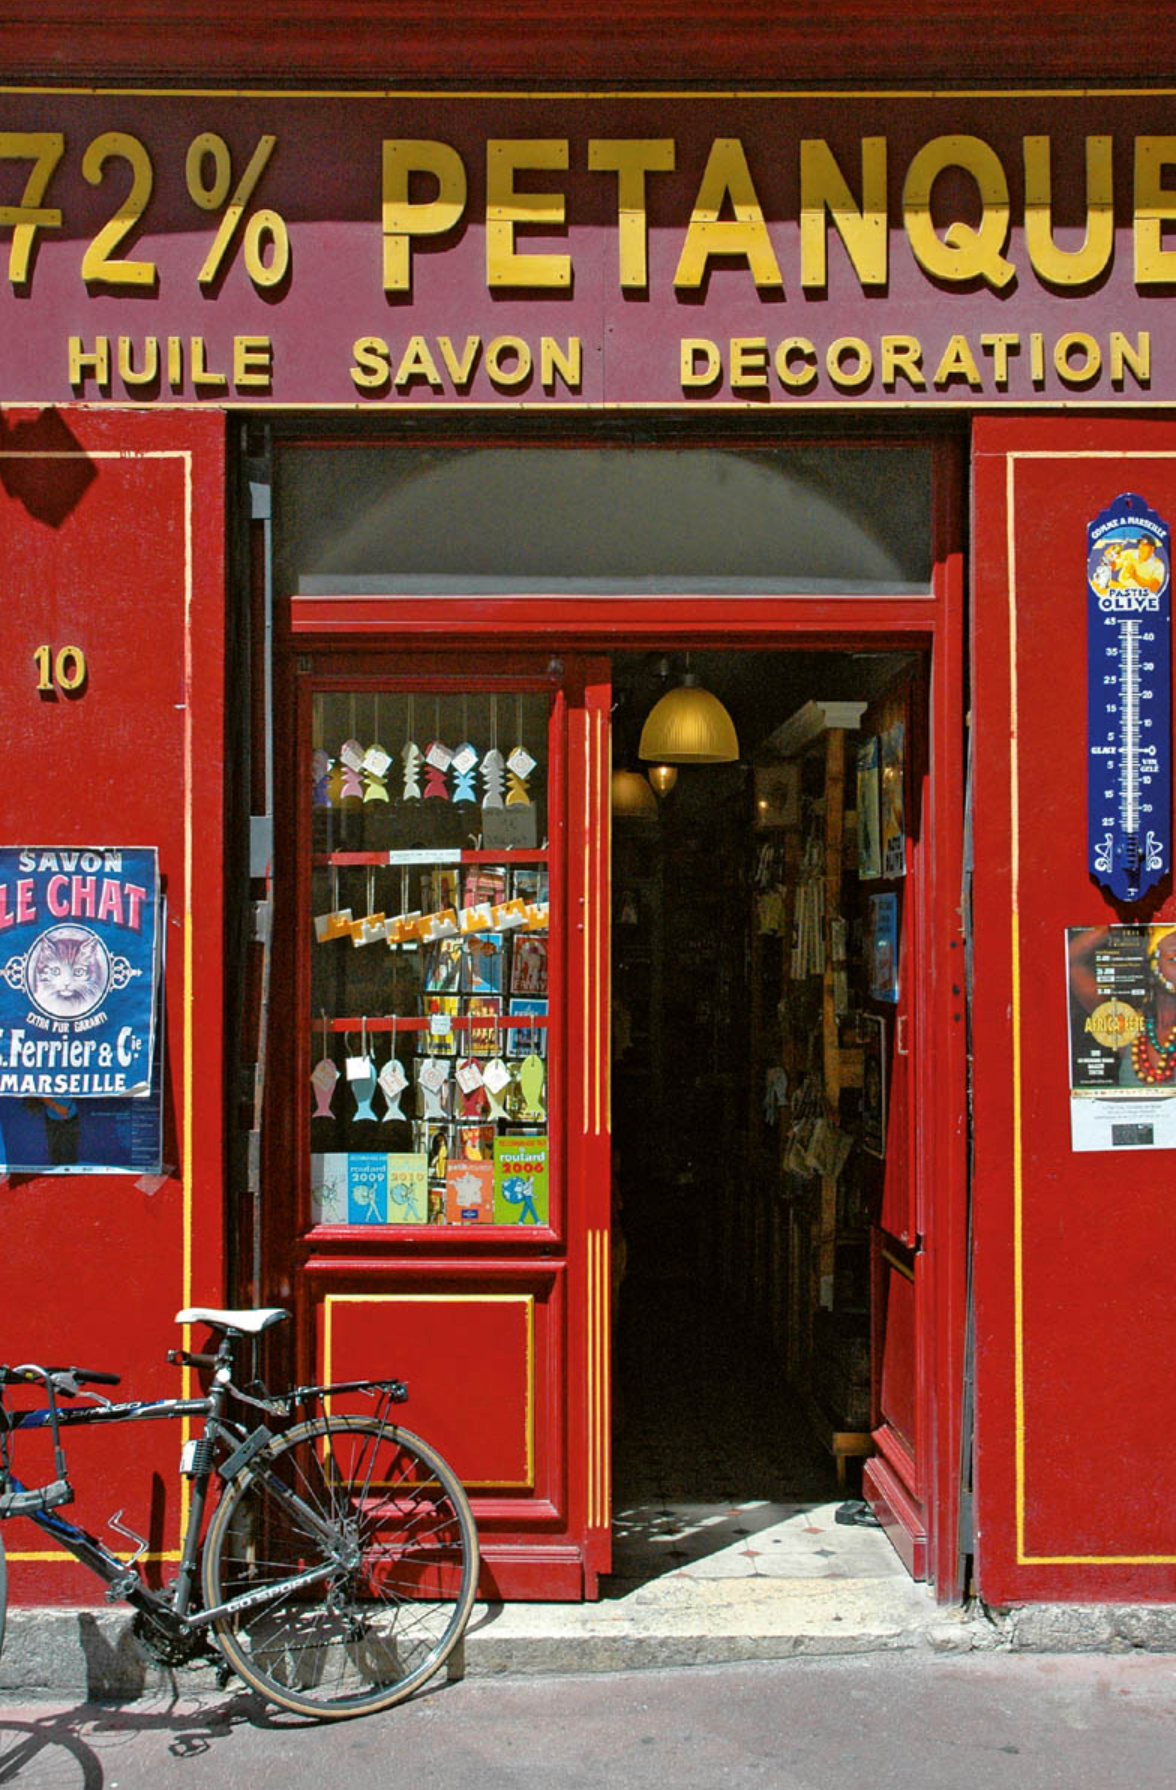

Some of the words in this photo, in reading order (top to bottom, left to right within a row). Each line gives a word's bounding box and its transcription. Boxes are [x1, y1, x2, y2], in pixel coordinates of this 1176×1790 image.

[68, 336, 271, 386] HUILE
[350, 336, 581, 388] SAVON
[680, 332, 1151, 387] DECORATION
[1109, 588, 1150, 598] PASTIS
[1100, 597, 1159, 612] OLIVE
[1104, 617, 1117, 626] 45
[1143, 632, 1155, 641] 40
[1105, 647, 1118, 656] 35
[34, 645, 86, 690] 10
[1143, 662, 1155, 671] 30
[1104, 675, 1117, 684] 25
[1142, 690, 1153, 699] 20
[1106, 704, 1117, 713] 15
[1107, 732, 1115, 741] 5
[19, 852, 122, 872] SAVON
[47, 874, 147, 930] CHAT
[51, 1021, 70, 1034] PUR
[74, 1011, 108, 1033] GARANTI
[1084, 1016, 1119, 1033] AFRICA
[98, 1042, 114, 1067] &
[0, 1073, 127, 1093] MARSEILLE
[500, 1151, 545, 1162] routard
[502, 1162, 544, 1174] 2006
[351, 1173, 385, 1182] 2009
[227, 1598, 252, 1612] GO
[256, 1577, 312, 1603] SPORT
